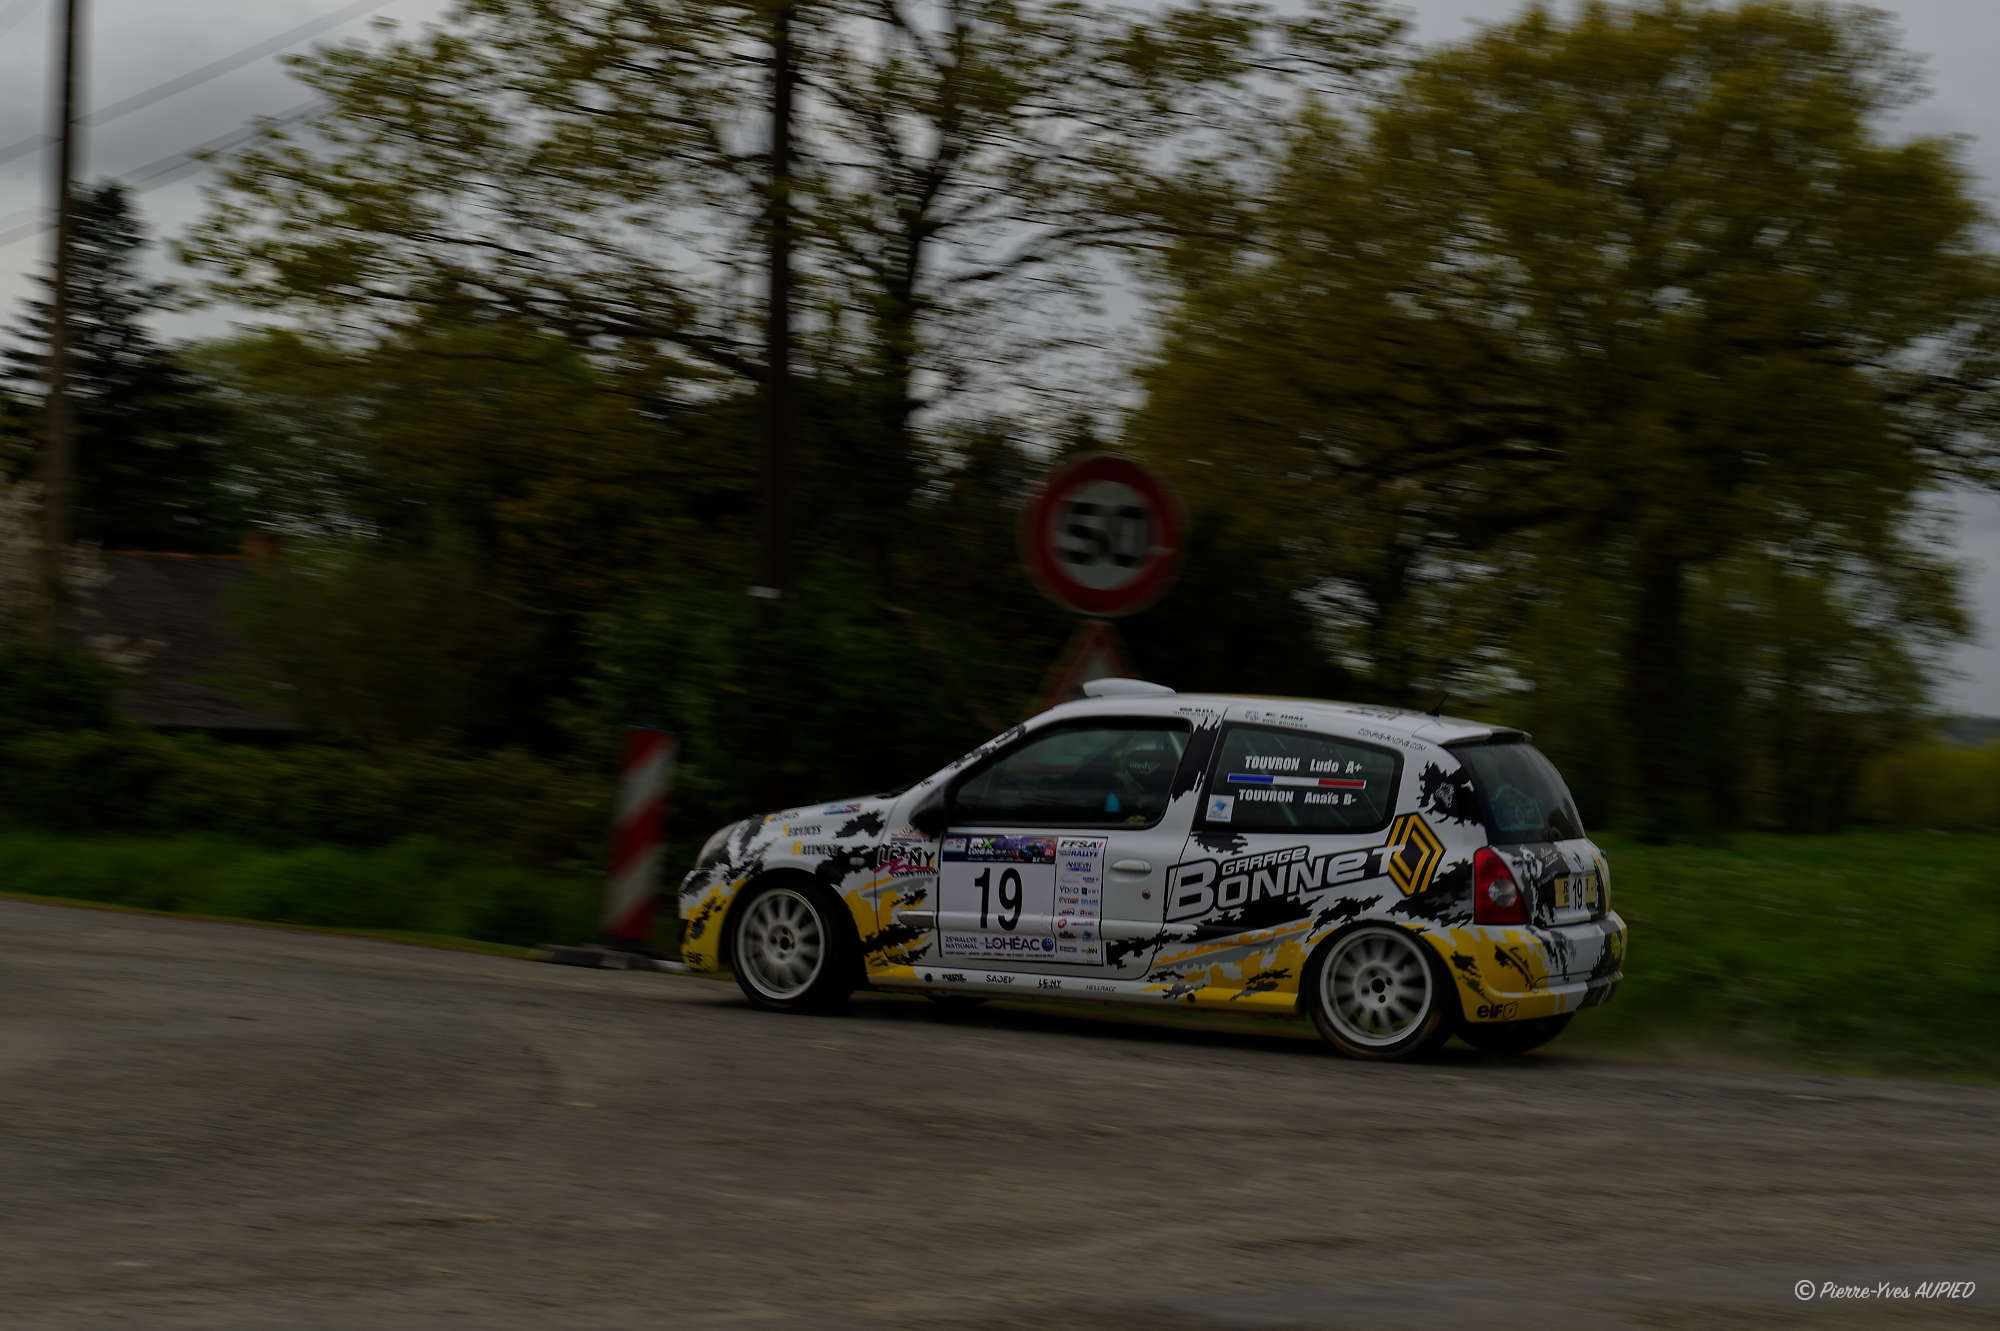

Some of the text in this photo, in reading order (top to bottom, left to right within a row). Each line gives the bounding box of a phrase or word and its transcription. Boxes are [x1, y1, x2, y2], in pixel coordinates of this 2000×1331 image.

[1061, 500, 1148, 568] 50
[1245, 755, 1363, 774] TOUVRON Ludo A+
[1238, 788, 1358, 806] TOUVRON Anaïs B-
[1221, 847, 1307, 876] GARAGE
[974, 867, 1023, 931] 19
[1572, 879, 1583, 910] 19
[985, 935, 1040, 951] LOHÉAC
